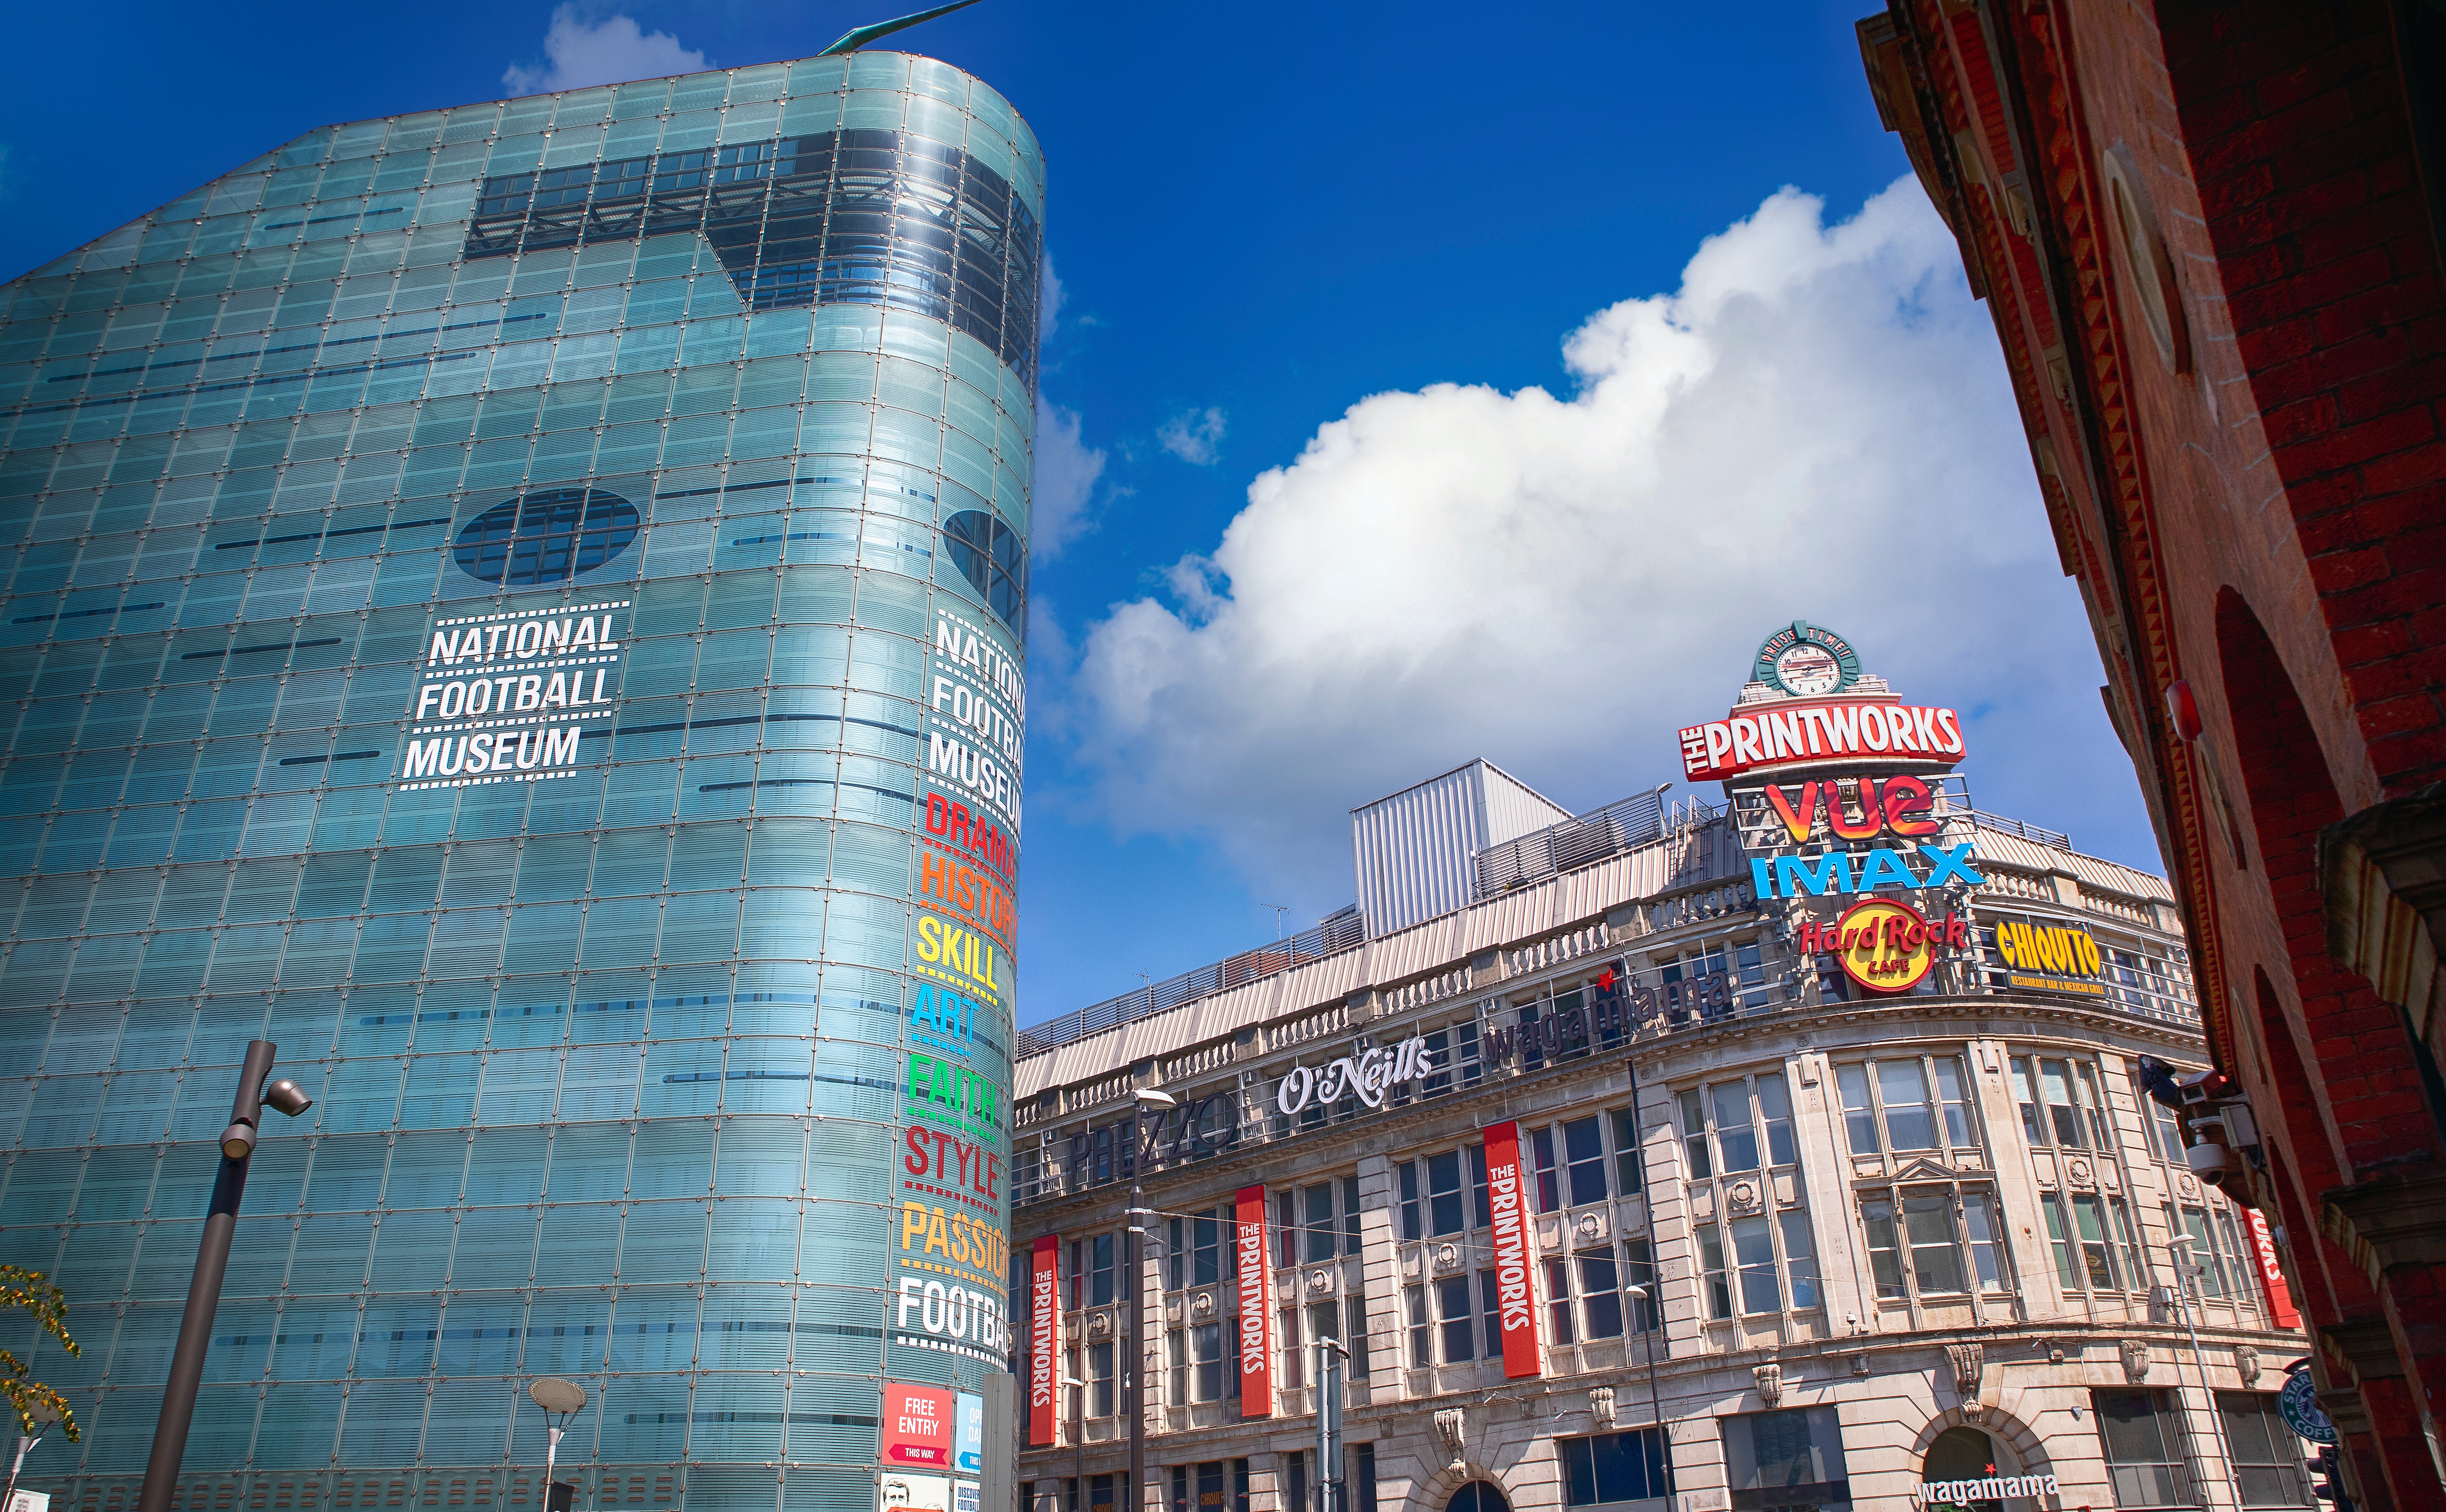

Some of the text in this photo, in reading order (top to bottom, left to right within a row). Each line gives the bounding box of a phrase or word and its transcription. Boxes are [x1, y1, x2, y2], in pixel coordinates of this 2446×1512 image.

[428, 615, 618, 667] NATIONAL
[1762, 630, 1796, 662] PRESS
[416, 669, 612, 722] FOOTBALL
[403, 726, 581, 778] MUSEUM
[1682, 705, 1963, 774] THE PRINTWORKS
[925, 792, 1015, 887] DRAMA
[1751, 842, 1987, 900] IMAX
[921, 852, 1018, 949] HISTORY
[917, 916, 997, 992] SKILL
[1797, 912, 1968, 955] Hard Rock
[1997, 921, 2101, 976] CHIQUITO
[1868, 959, 1910, 974] CAFE
[2011, 976, 2105, 994] RESTAURANT BAR & MEXICAN GRILL
[911, 983, 979, 1044] ART
[1483, 969, 1733, 1061] wagamama
[908, 1053, 996, 1128] FAITH
[1278, 1036, 1432, 1115] O'Neill's
[905, 1125, 998, 1201] STYLE
[1069, 1091, 1240, 1186] PREZZO
[1490, 1164, 1530, 1331] THE PRINTWORKS
[1240, 1223, 1265, 1374] THE PRINTWORKS
[1033, 1270, 1052, 1408] THE PRINTWORKS
[898, 1417, 939, 1436] ENTRY
[905, 1397, 935, 1417] FREE
[905, 1448, 935, 1459] THIS WAY
[969, 1456, 978, 1466] THIS
[1914, 1473, 2059, 1507] wagamama
